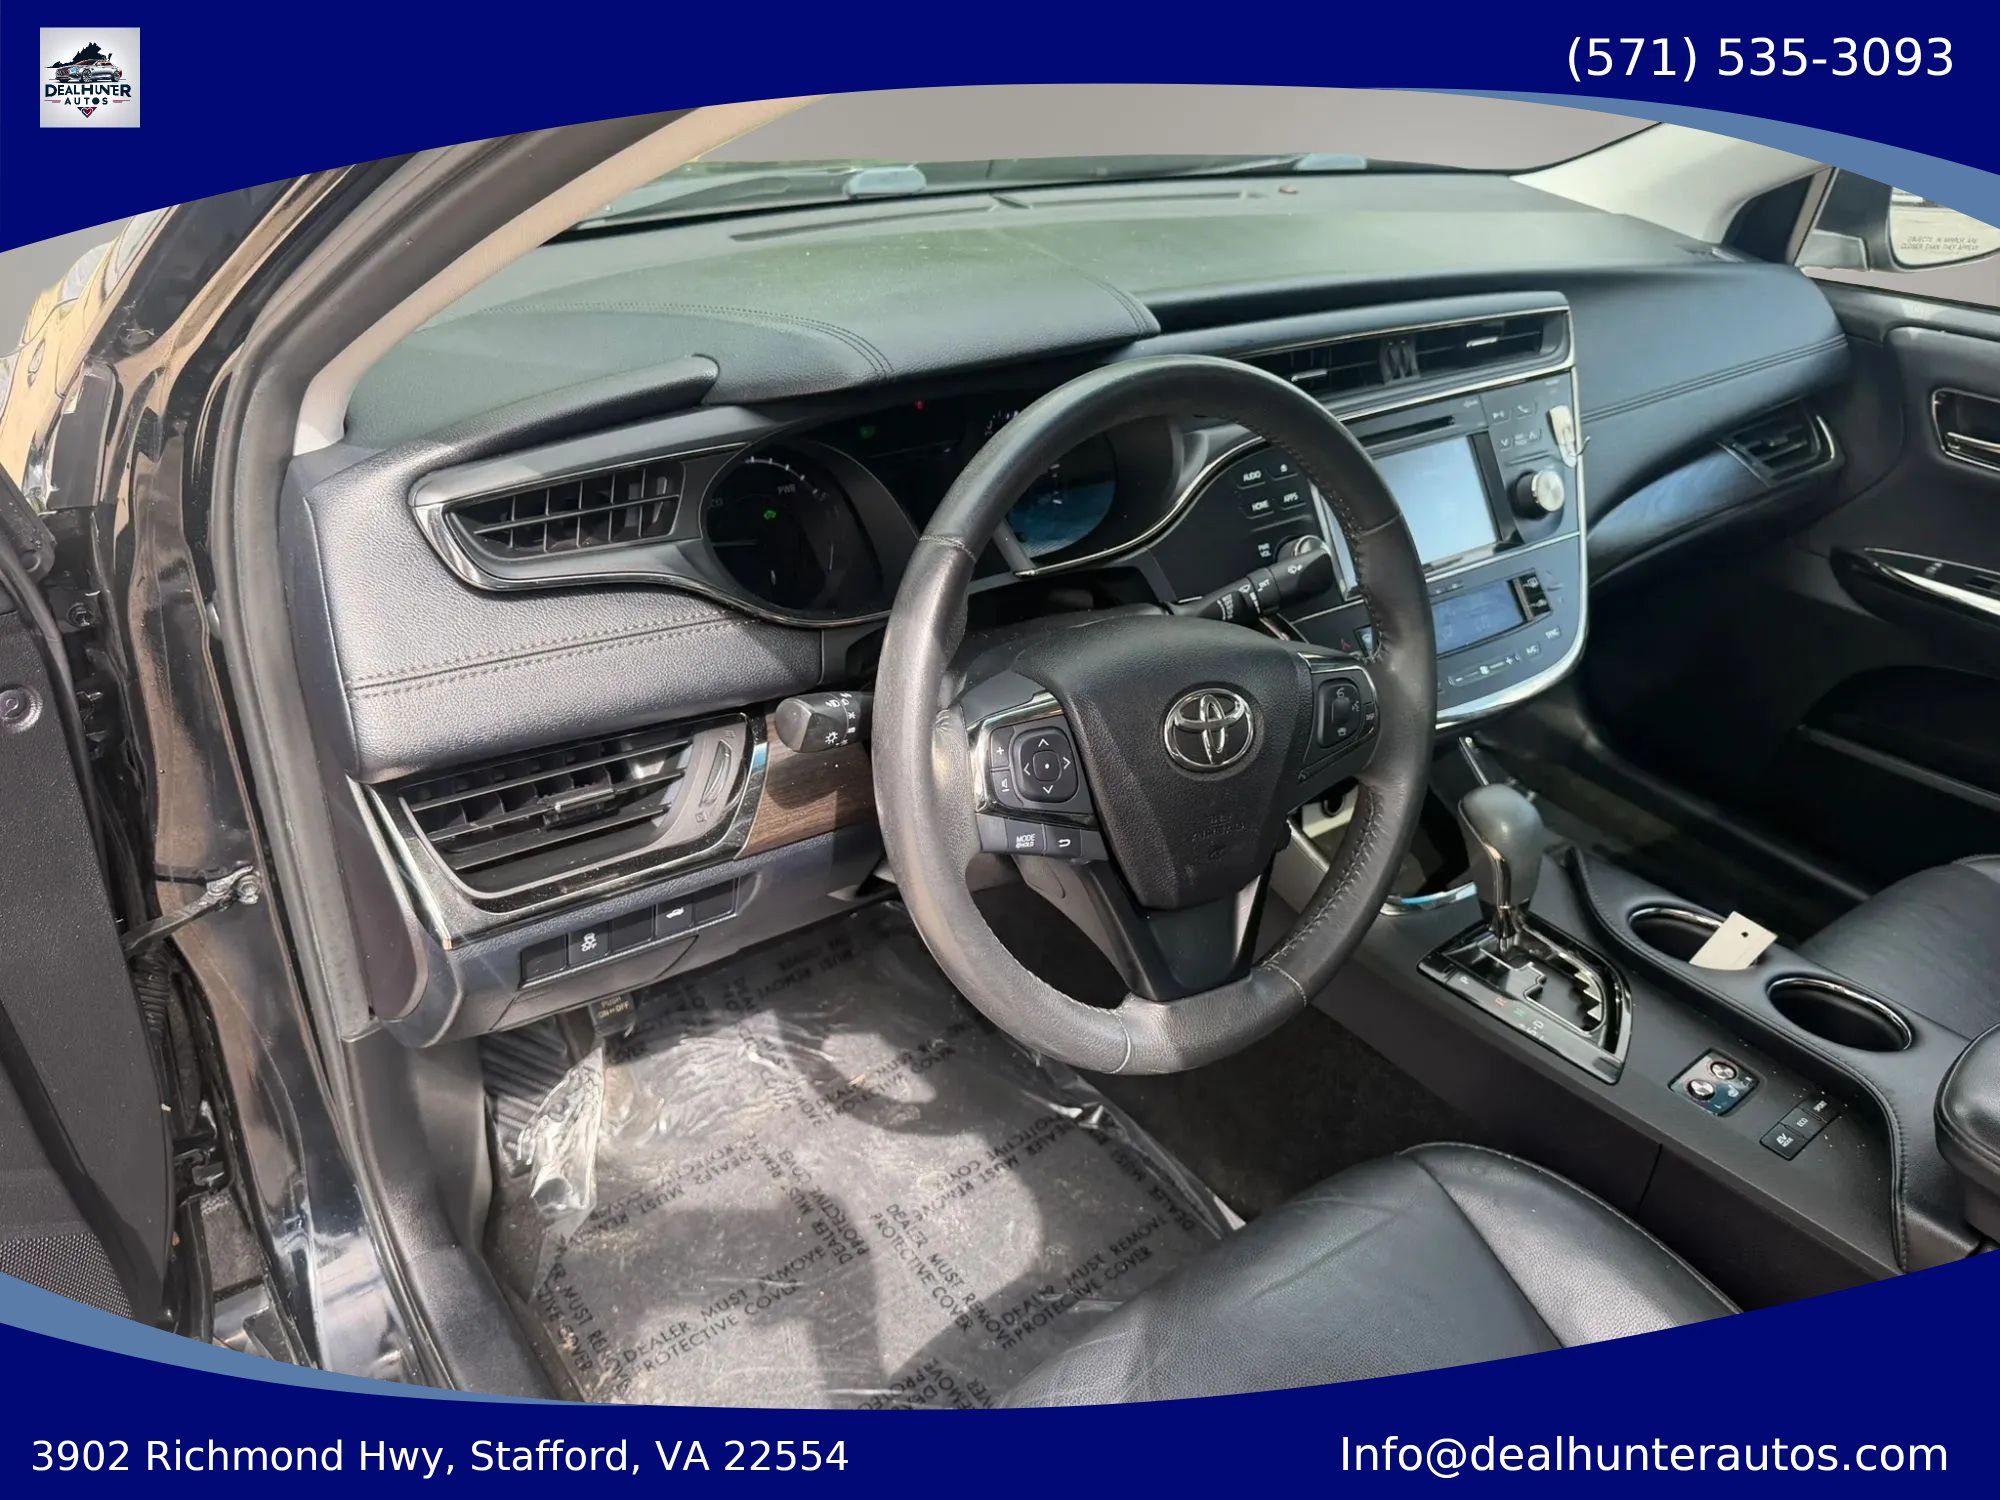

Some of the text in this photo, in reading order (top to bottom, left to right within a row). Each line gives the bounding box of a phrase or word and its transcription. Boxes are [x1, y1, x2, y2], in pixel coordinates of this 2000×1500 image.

[1016, 833, 1036, 842] MODE
[1796, 1117, 1808, 1127] ECO
[808, 1180, 870, 1260] PROTECTIVE
[810, 1214, 853, 1268] DEALER
[1062, 1252, 1106, 1286] MUST
[1108, 1212, 1168, 1257] REMOVE
[867, 1207, 975, 1335] PROTECTIVE COVER
[885, 1199, 1017, 1354] DEALER MUST REMOVE
[1102, 1243, 1154, 1283] COVER
[621, 1319, 692, 1364] DEALER
[698, 1287, 750, 1322] MUST
